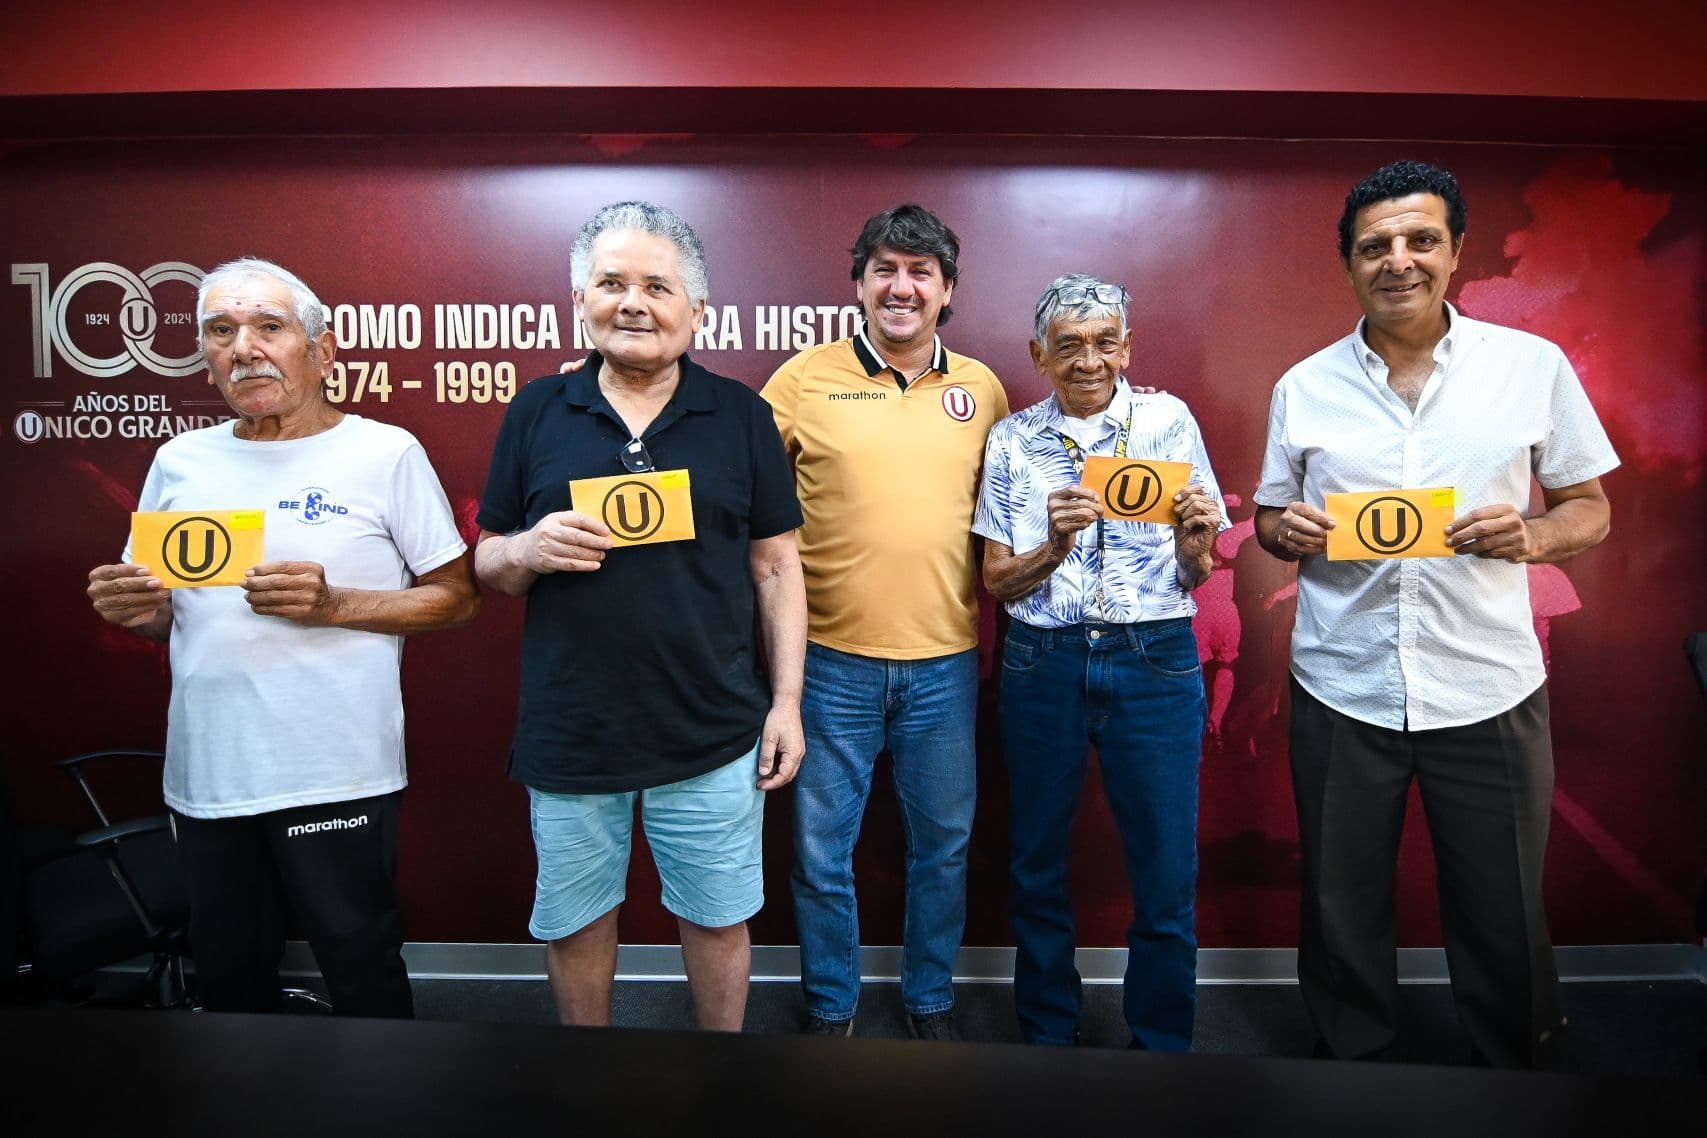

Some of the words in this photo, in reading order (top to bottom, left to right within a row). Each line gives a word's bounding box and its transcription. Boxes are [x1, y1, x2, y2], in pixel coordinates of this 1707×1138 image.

[85, 313, 110, 325] 1924
[127, 306, 149, 336] U
[164, 313, 192, 325] 2024
[320, 304, 422, 350] OMO
[434, 304, 561, 350] INDICA
[755, 305, 862, 350] HISTO
[326, 361, 393, 403] 974
[433, 361, 516, 403] 1999
[828, 391, 887, 401] marathon
[72, 391, 129, 413] AÑOS
[133, 395, 172, 412] DEL
[279, 500, 301, 510] BE
[1117, 475, 1150, 510] U
[616, 492, 650, 533] U
[1372, 508, 1406, 547] U
[179, 530, 214, 573] U
[287, 815, 368, 838] marathon
